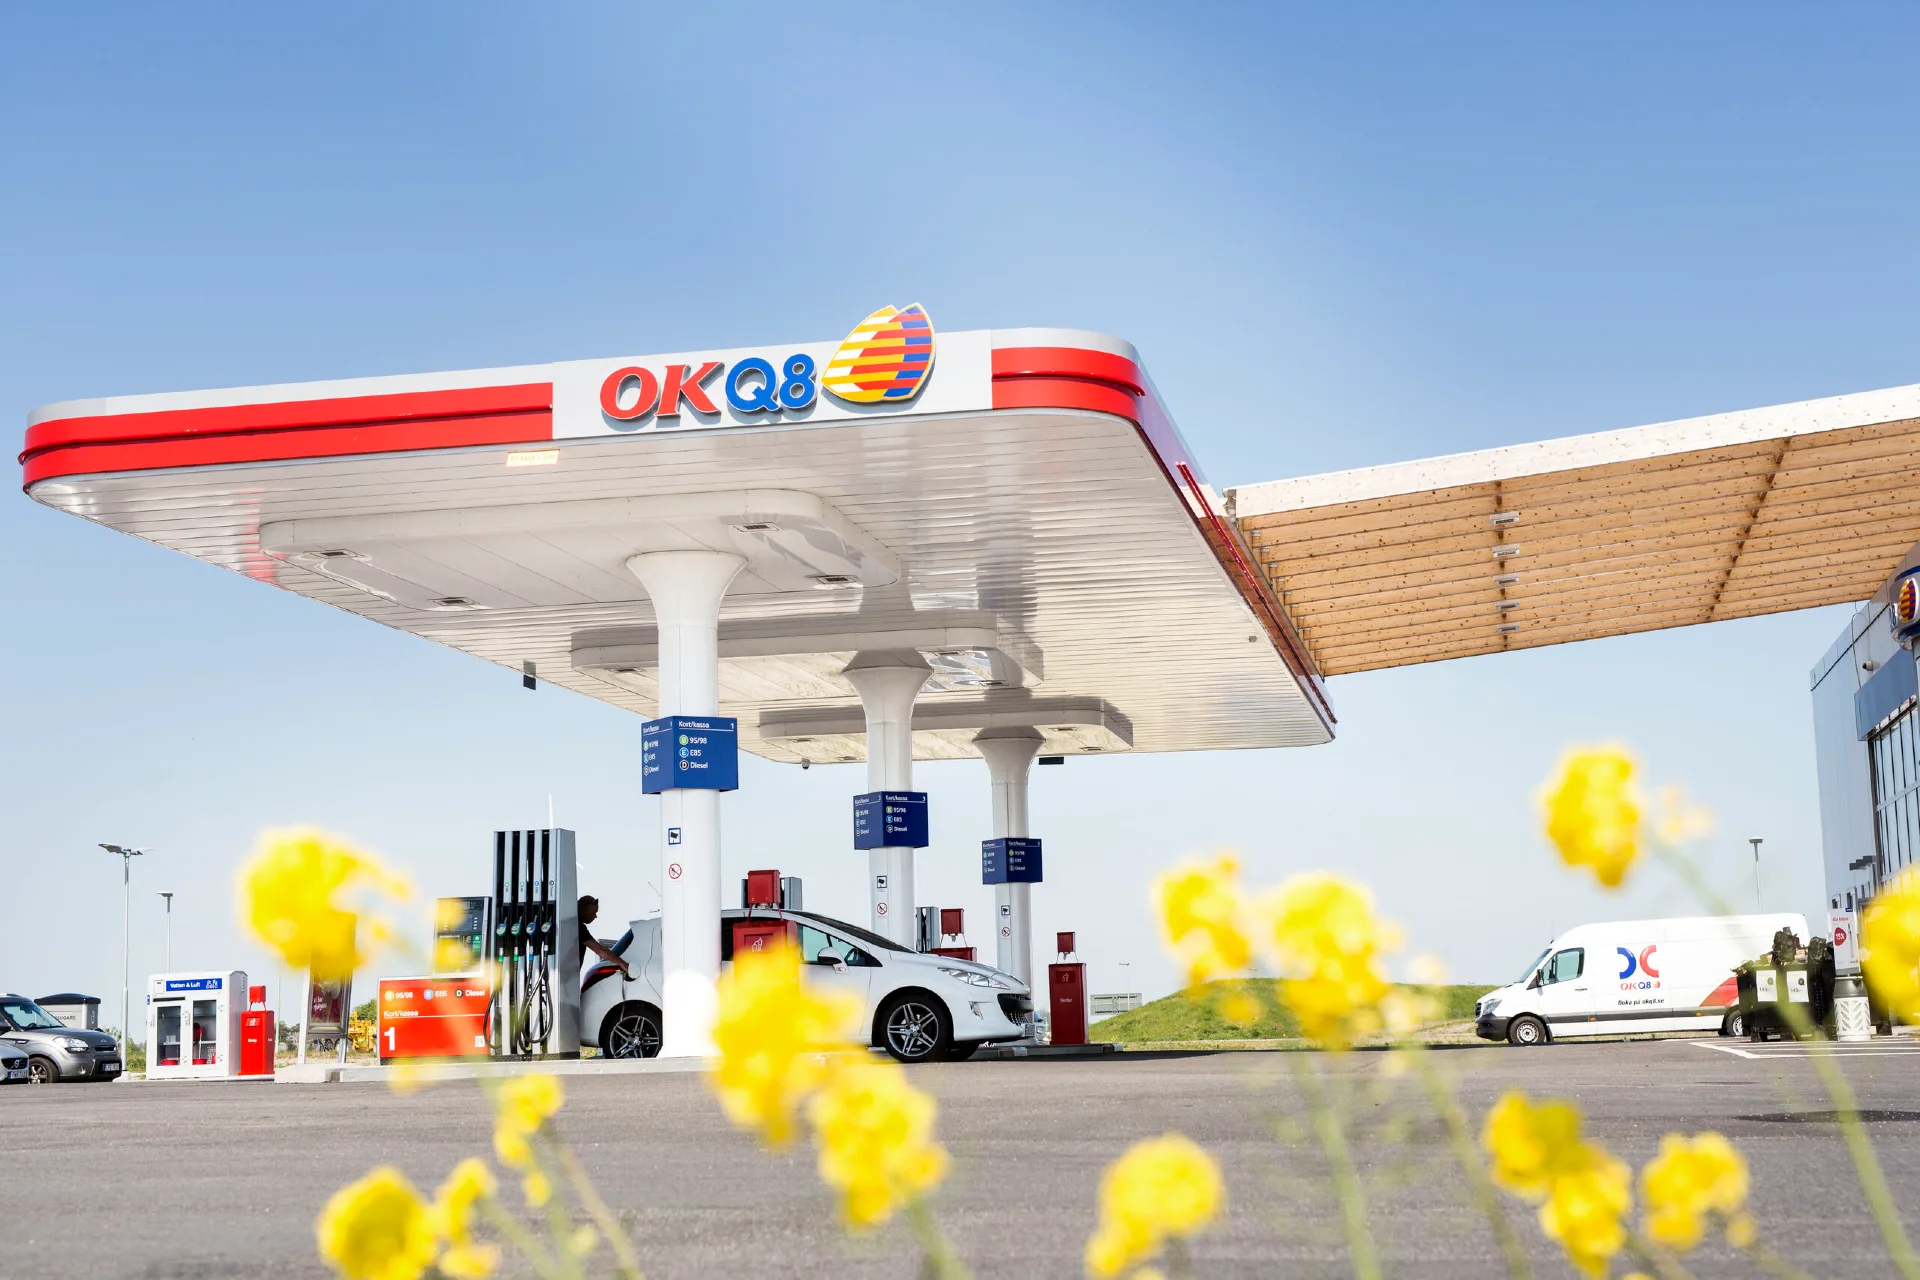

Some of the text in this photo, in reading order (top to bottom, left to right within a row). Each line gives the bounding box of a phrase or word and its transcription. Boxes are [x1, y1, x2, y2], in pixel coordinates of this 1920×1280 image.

[599, 353, 817, 420] OKQ8
[679, 720, 710, 728] Kort/kassa
[384, 1026, 396, 1050] 1
